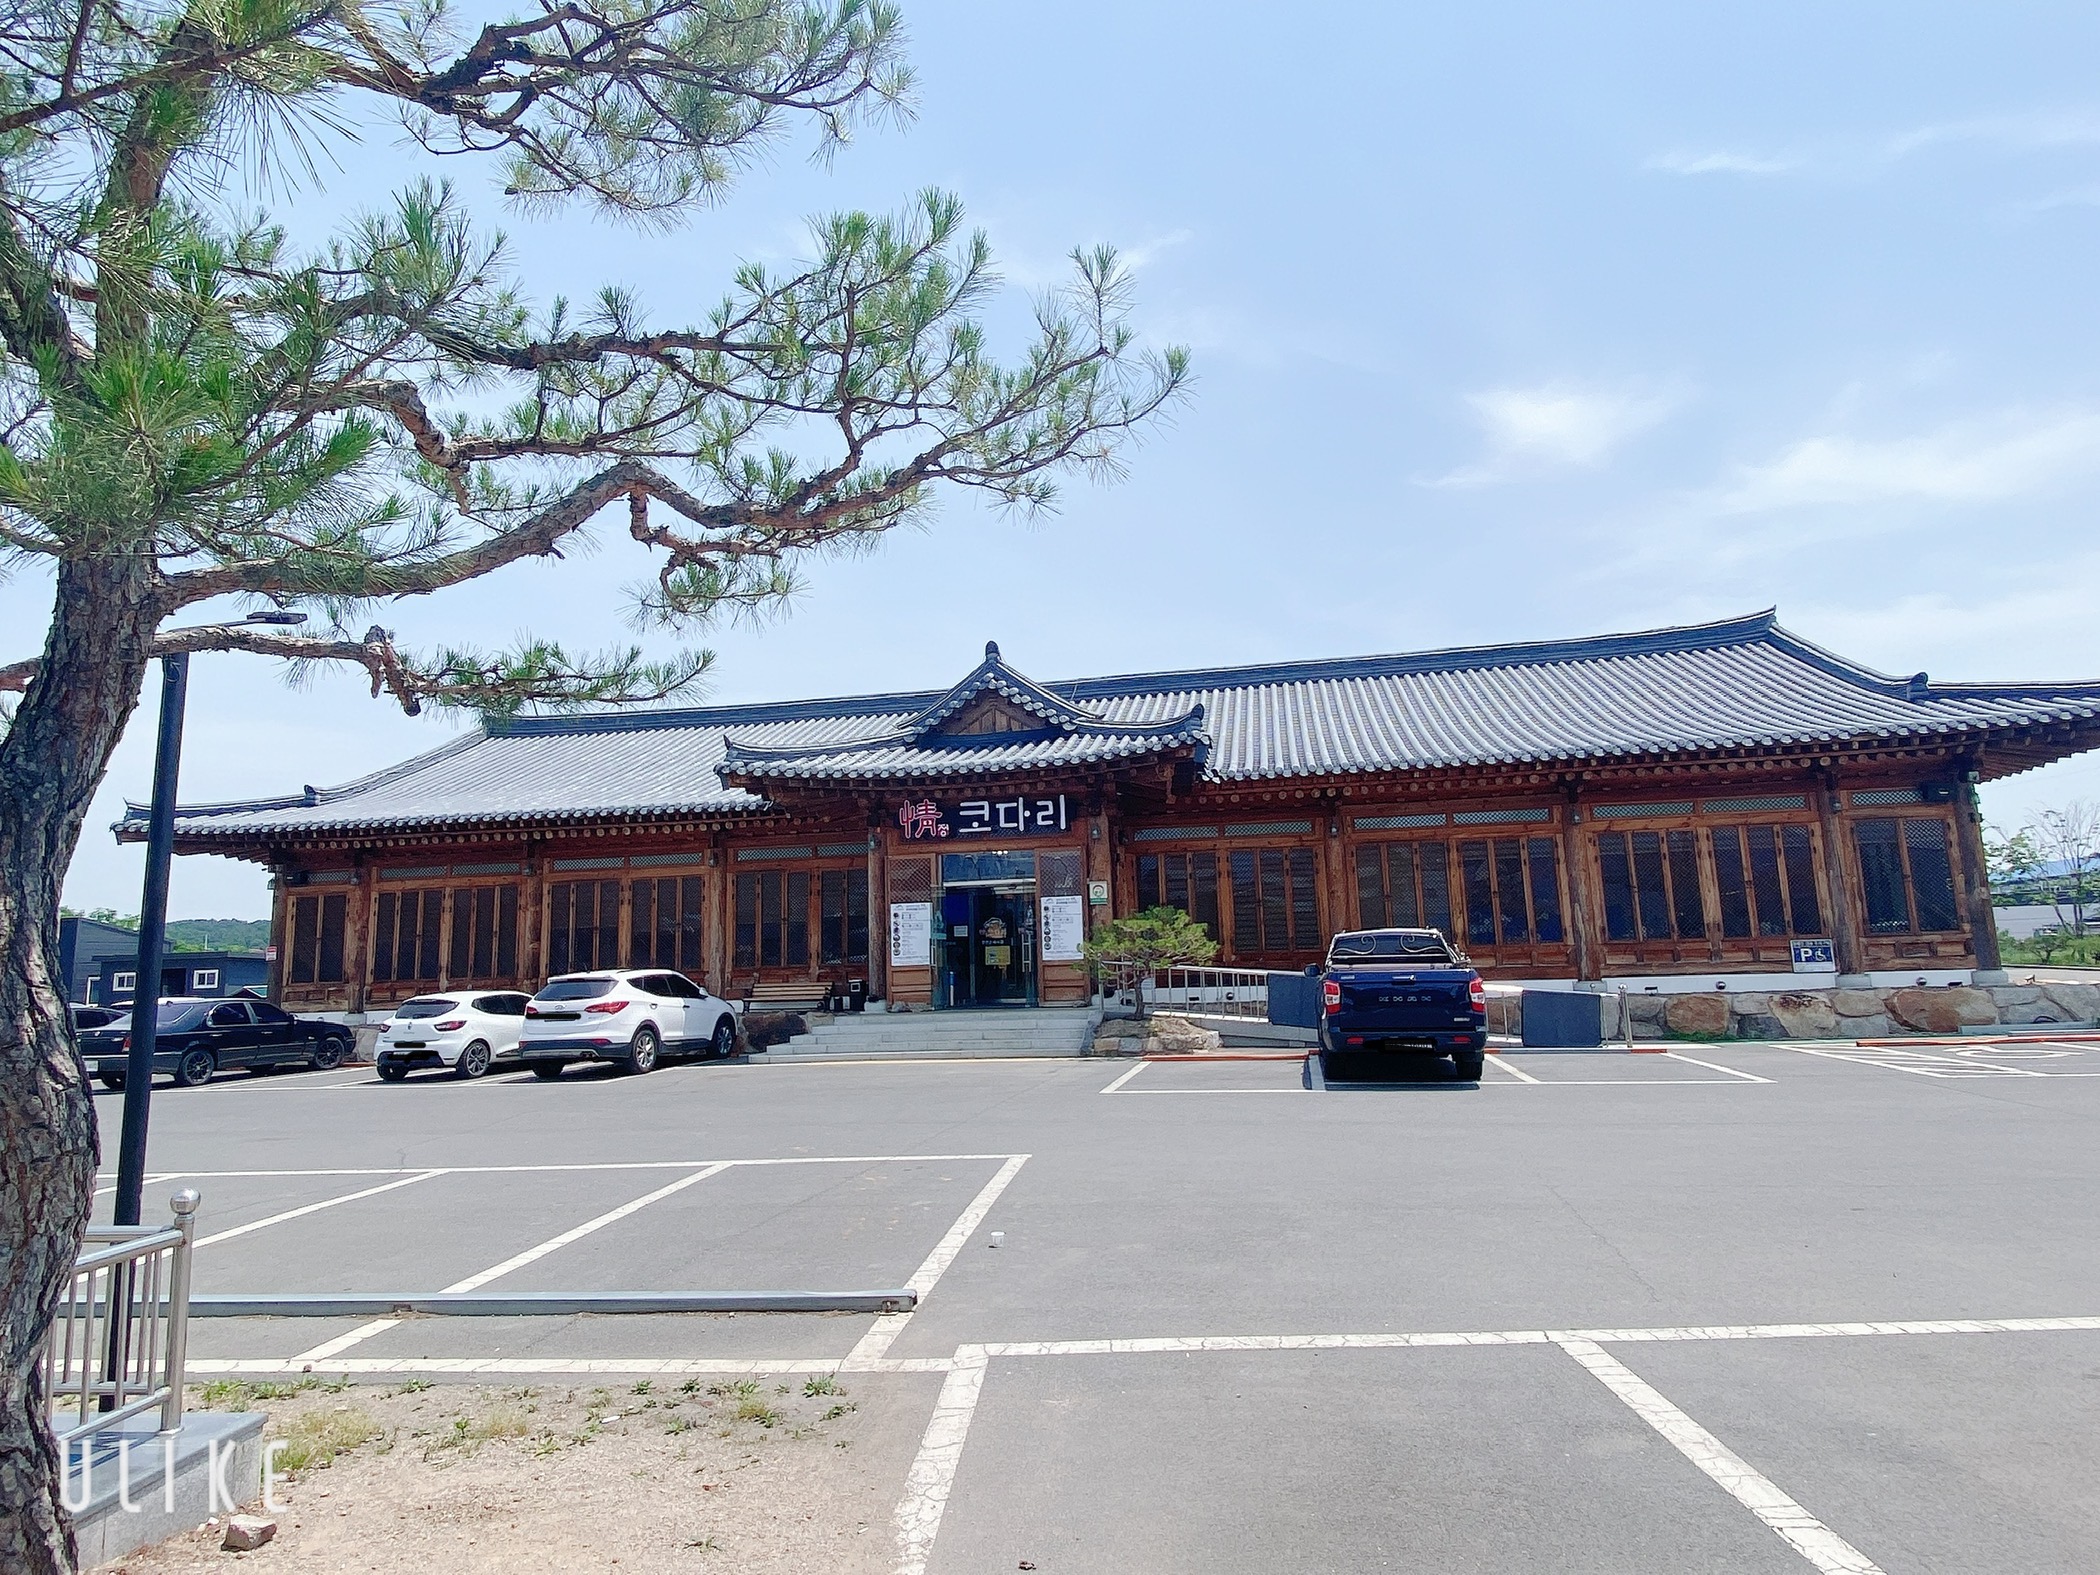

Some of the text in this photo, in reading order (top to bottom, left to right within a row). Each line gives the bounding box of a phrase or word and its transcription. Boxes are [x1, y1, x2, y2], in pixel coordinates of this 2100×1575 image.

[899, 798, 944, 840] 情
[958, 793, 1067, 834] 코다리
[1800, 948, 1813, 962] P
